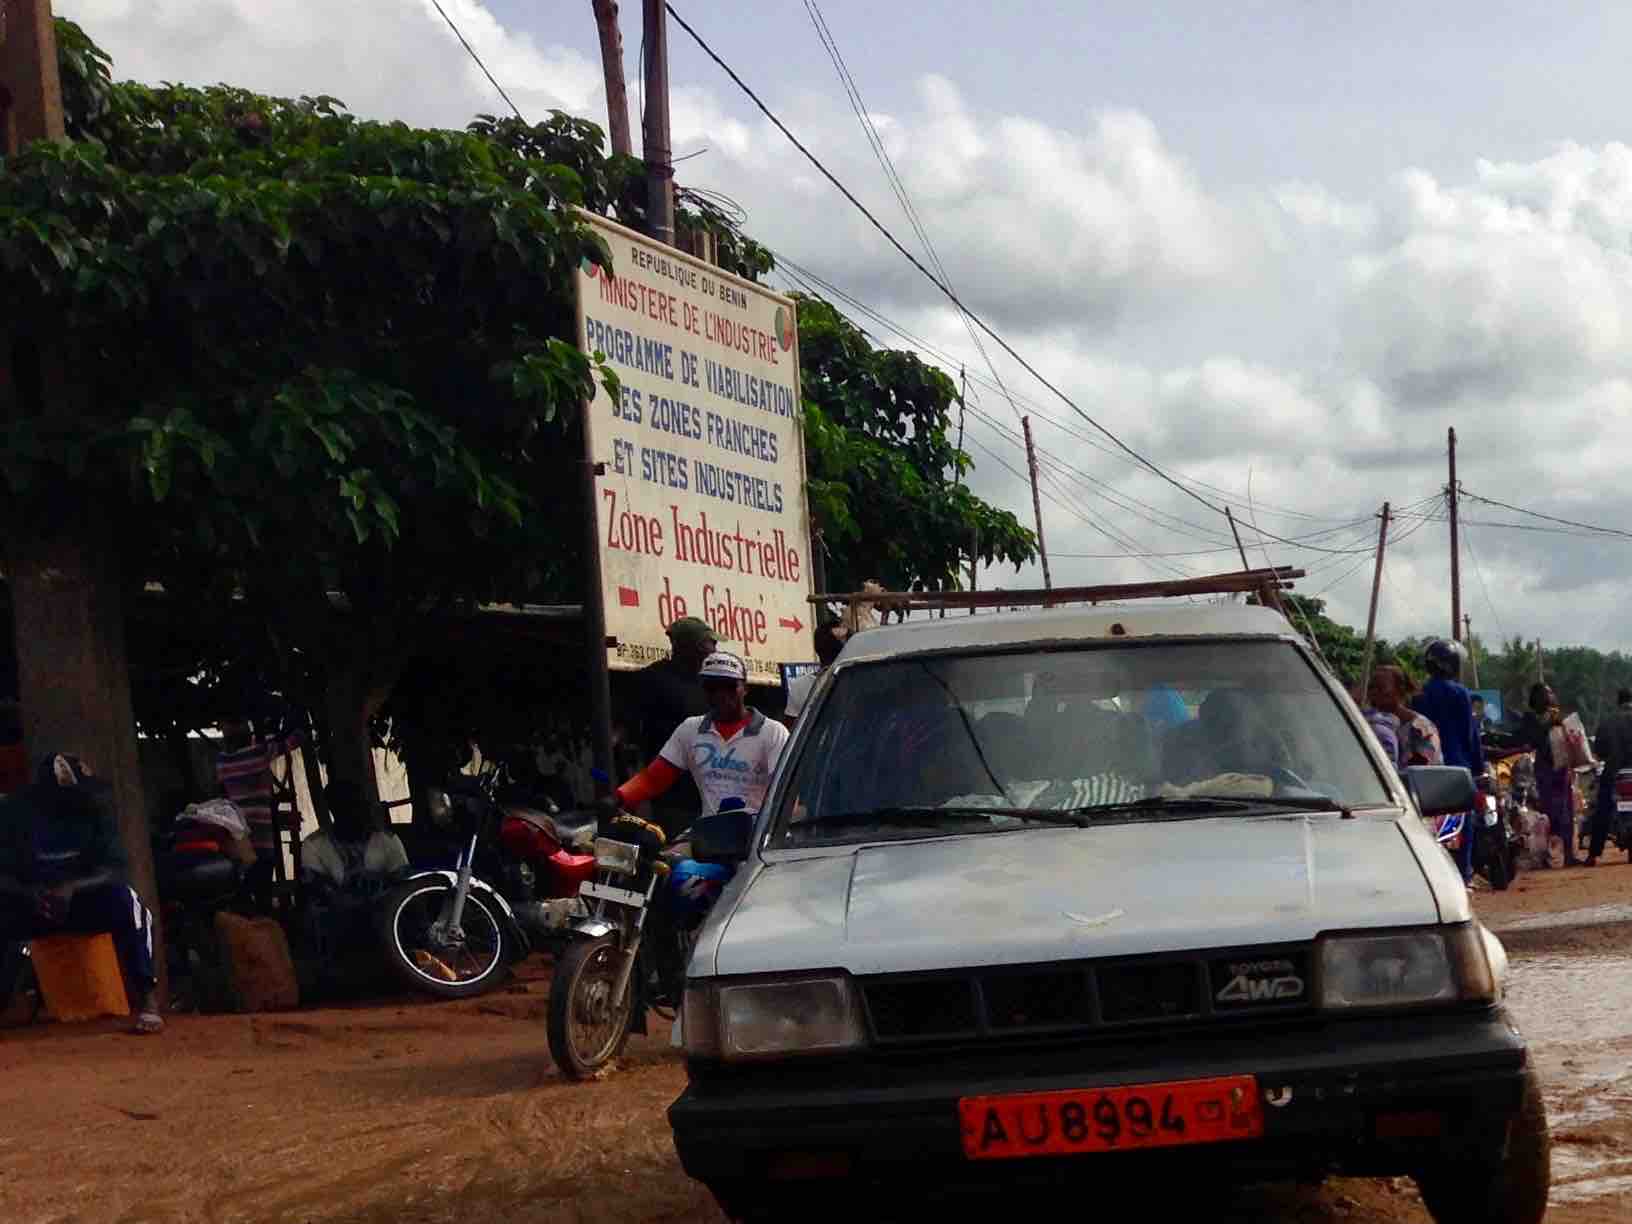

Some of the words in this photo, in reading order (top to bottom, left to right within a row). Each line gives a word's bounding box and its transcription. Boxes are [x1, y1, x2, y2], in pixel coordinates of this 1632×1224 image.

[631, 247, 697, 290] REPUBLIQUE
[701, 276, 716, 297] DU
[719, 285, 747, 311] BENIN
[599, 272, 678, 327] MINISTERE
[683, 301, 701, 337] DE
[704, 311, 779, 366] L'INDUSTRIE
[586, 315, 674, 381] PROGRAMME
[680, 350, 700, 389] DE
[705, 361, 794, 420] VIABILISATION
[648, 394, 703, 441] ZONES
[706, 411, 779, 464] FRANCHES
[613, 438, 634, 477] ET
[641, 447, 689, 490] SITES
[694, 459, 783, 514] INDUSTRIELS
[603, 488, 664, 558] Zone
[670, 505, 800, 583] Industrielle
[1216, 975, 1305, 1001] 4WD
